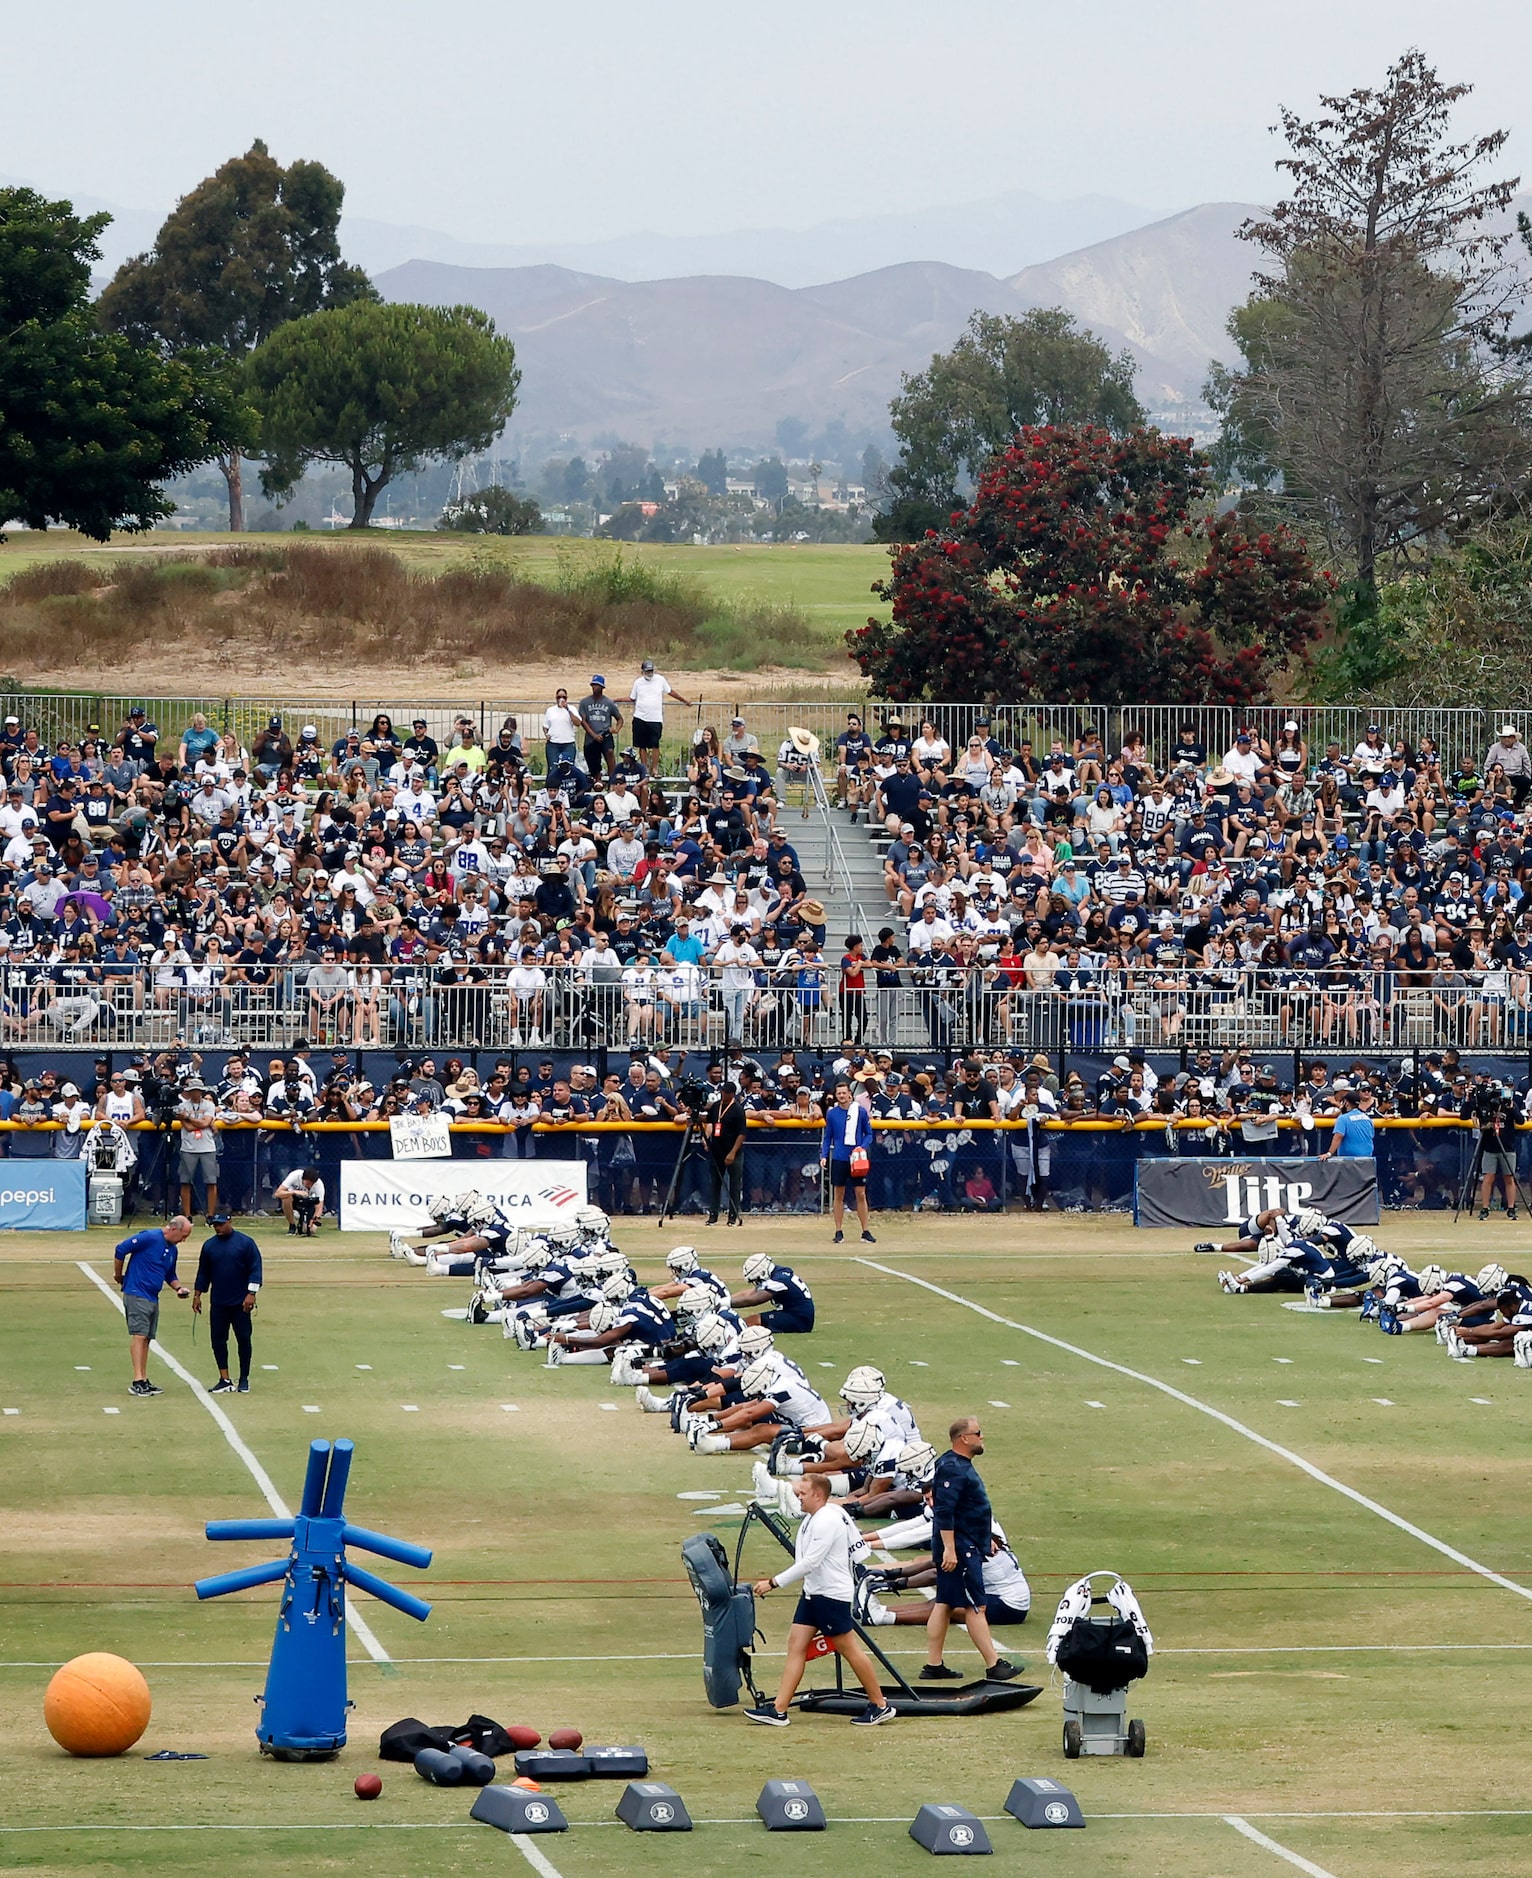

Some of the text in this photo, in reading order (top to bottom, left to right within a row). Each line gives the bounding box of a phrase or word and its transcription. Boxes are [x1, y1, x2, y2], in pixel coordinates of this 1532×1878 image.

[1144, 811, 1166, 829] 88
[395, 1138, 420, 1154] DEM
[0, 1187, 54, 1207] pepsi
[347, 1193, 402, 1206] BANK
[409, 1193, 434, 1206] OF
[1223, 1174, 1313, 1225] lite
[816, 1637, 829, 1653] G
